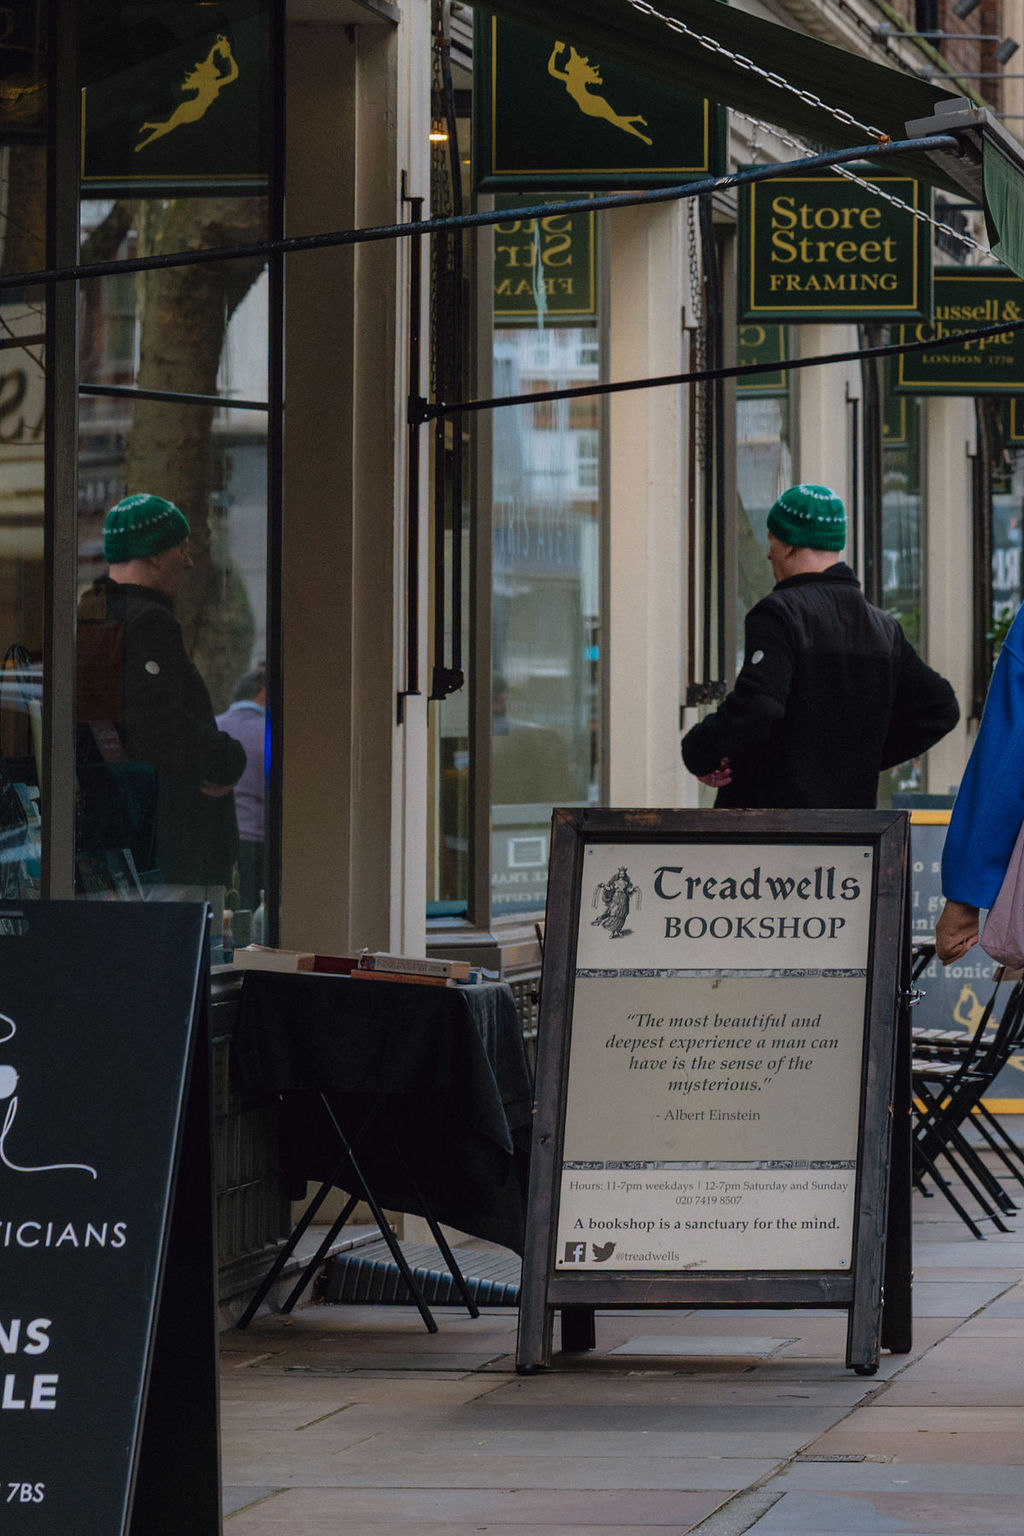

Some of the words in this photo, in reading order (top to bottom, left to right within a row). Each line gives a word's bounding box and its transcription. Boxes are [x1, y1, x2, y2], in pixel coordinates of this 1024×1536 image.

[771, 196, 882, 230] Store
[770, 230, 898, 263] Street
[769, 274, 899, 292] FRAMING
[933, 299, 999, 321] ussell
[1001, 300, 1022, 321] &
[653, 866, 861, 901] Treadwells
[664, 916, 846, 939] BOOKSHOP
[627, 1013, 664, 1028] "The
[668, 1015, 708, 1028] most
[713, 1014, 786, 1032] beautiful
[791, 1014, 822, 1028] and
[605, 1034, 665, 1052] deepest
[669, 1037, 752, 1053] experience
[756, 1039, 766, 1049] a
[771, 1039, 806, 1049] man
[810, 1039, 839, 1049] can
[628, 1056, 667, 1070] have
[672, 1056, 685, 1070] is
[691, 1056, 716, 1070] the
[719, 1059, 762, 1070] sense
[767, 1055, 787, 1074] of
[788, 1056, 813, 1070] the
[668, 1077, 773, 1095] mysterious."
[664, 1109, 705, 1121] Albert
[709, 1109, 761, 1121] Einstein
[569, 1181, 603, 1191] Hours:
[606, 1181, 643, 1192] 11-7pm
[645, 1181, 694, 1193] weekdays
[705, 1181, 741, 1193] 12-7pm
[743, 1180, 788, 1192] Saturday
[790, 1181, 809, 1191] and
[811, 1181, 849, 1193] Sunday
[675, 1195, 693, 1205] 020
[695, 1195, 718, 1205] 7419
[719, 1195, 742, 1205] 8507
[0, 1221, 127, 1248] ICIANS
[573, 1218, 584, 1229] A
[588, 1217, 655, 1233] bookshop
[659, 1218, 671, 1229] is
[674, 1221, 681, 1229] a
[684, 1218, 749, 1233] sanctuary
[753, 1217, 773, 1230] for
[776, 1218, 797, 1230] the
[801, 1217, 840, 1230] mind.
[615, 1251, 680, 1262] @treadwells
[7, 1482, 46, 1503] 7BS
